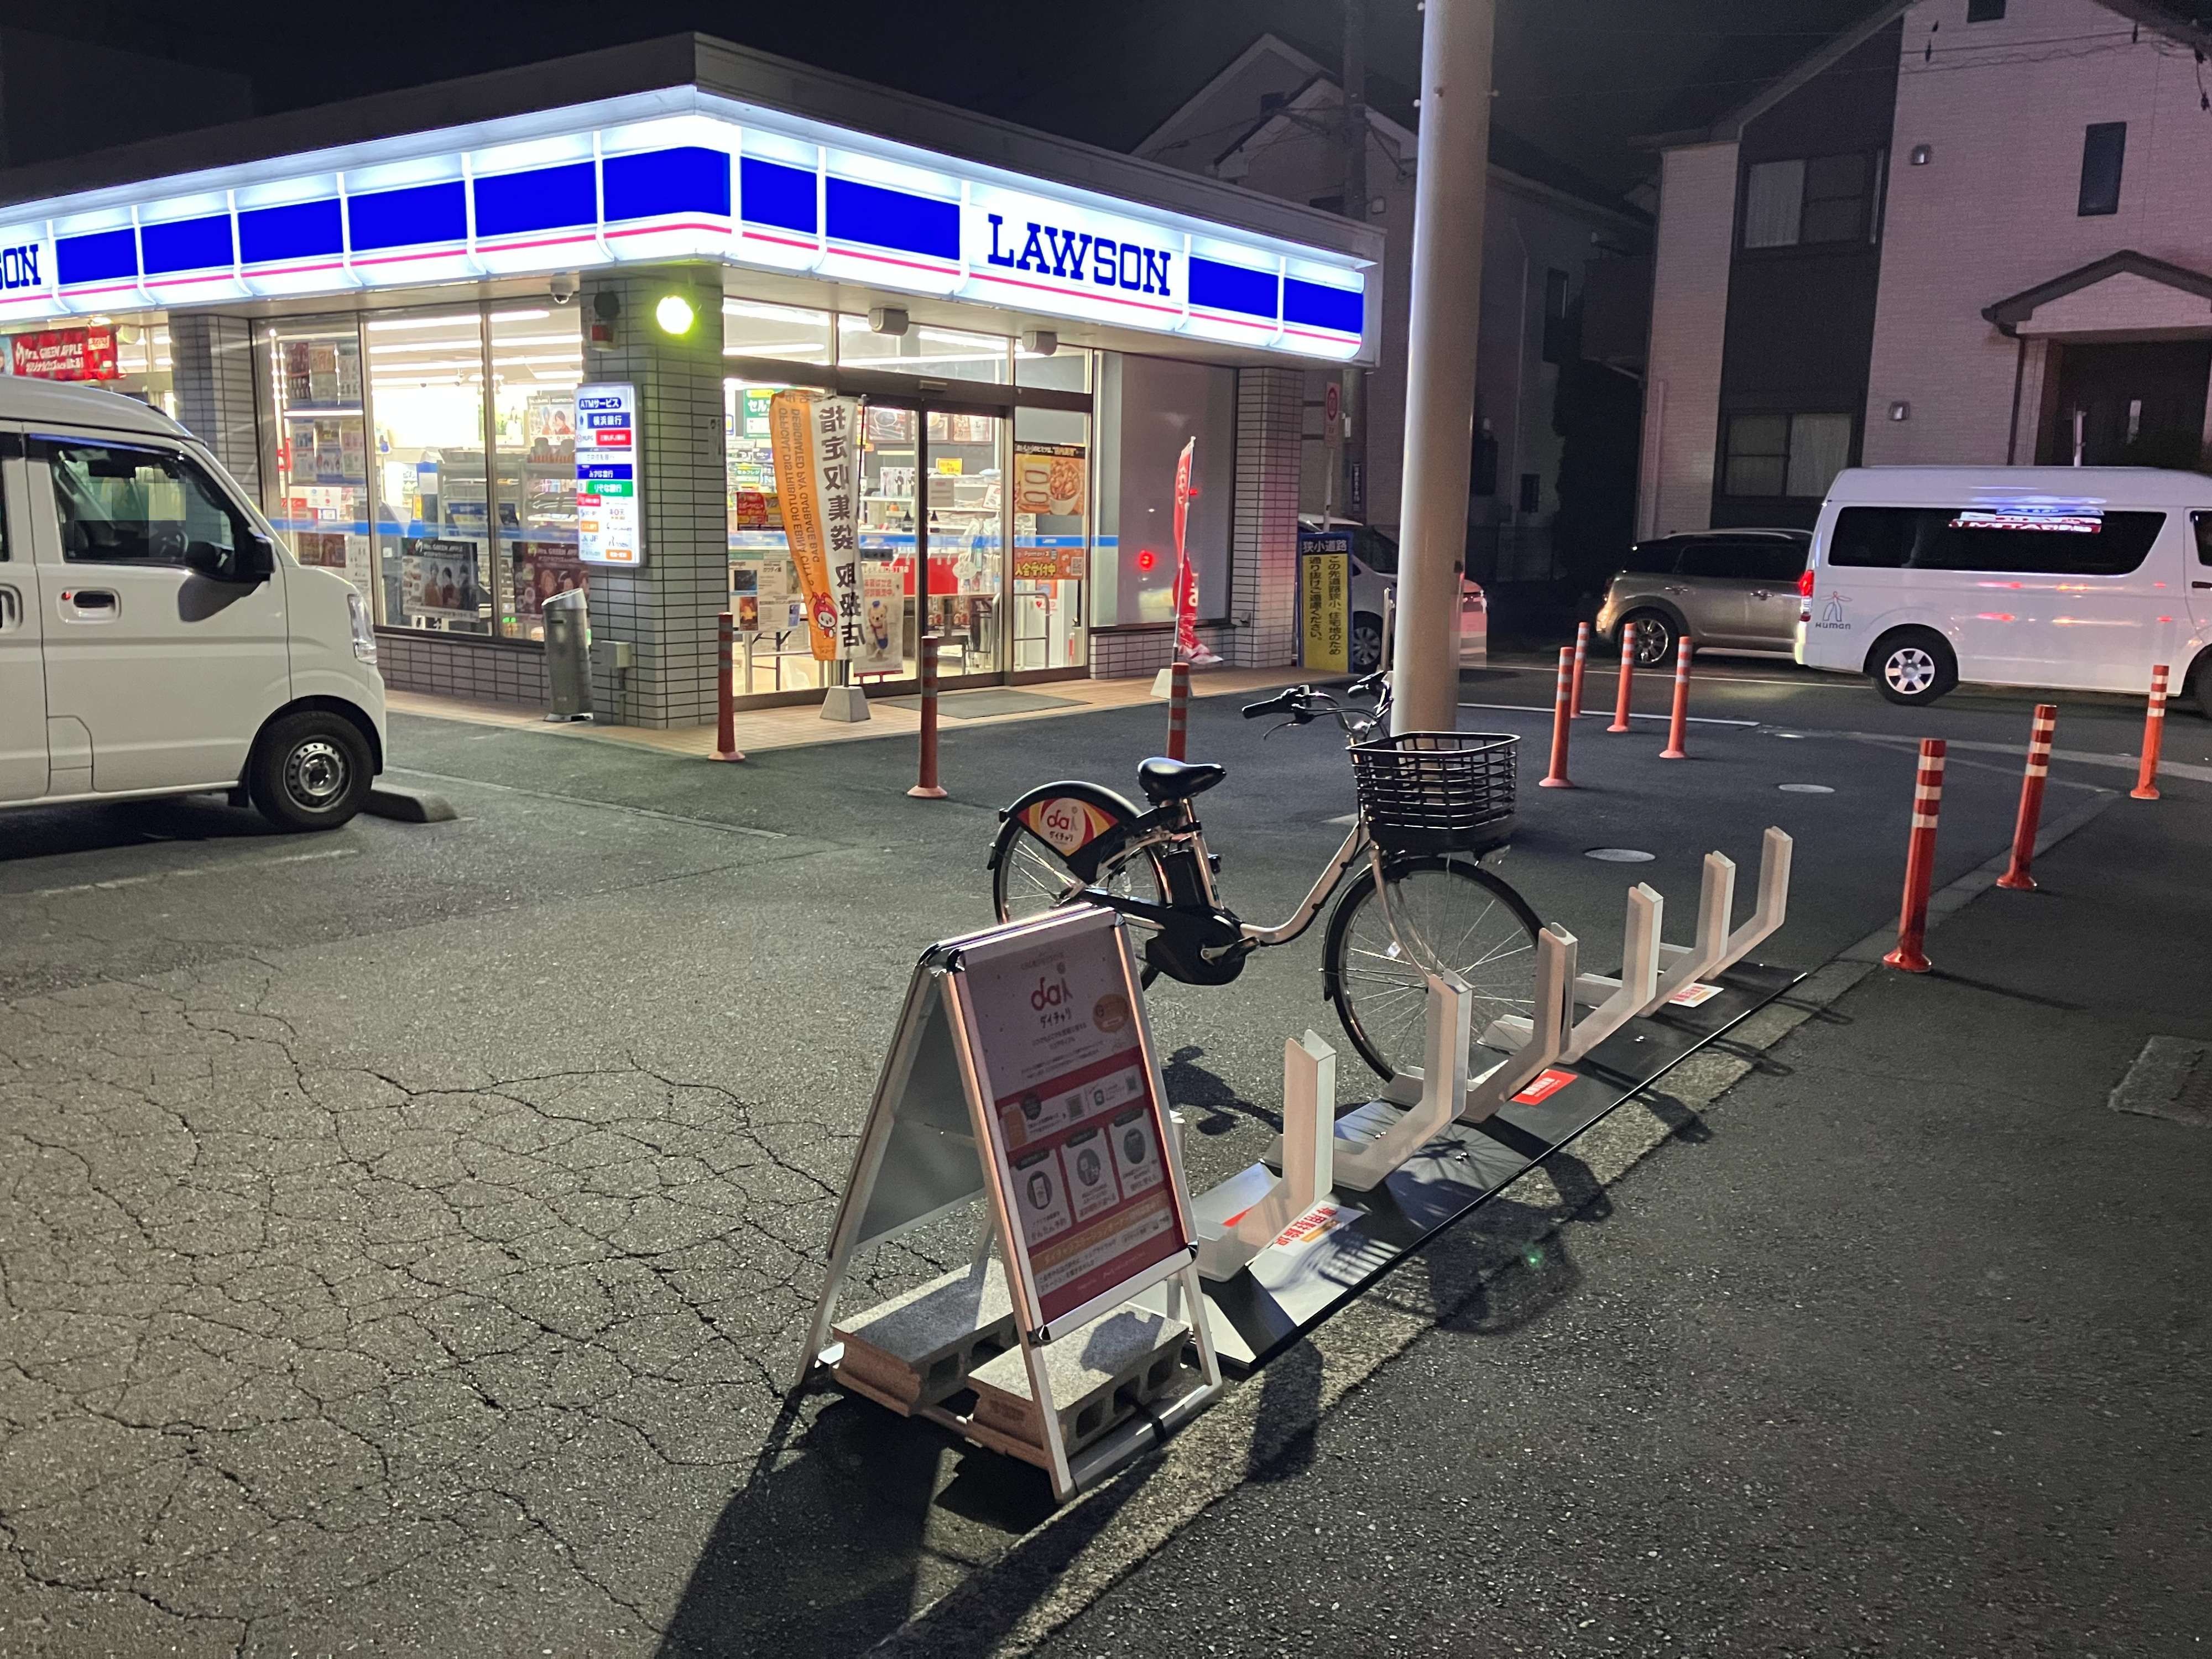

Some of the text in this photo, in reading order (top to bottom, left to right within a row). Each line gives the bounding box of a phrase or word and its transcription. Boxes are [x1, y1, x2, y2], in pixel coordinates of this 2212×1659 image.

[988, 213, 1171, 296] LAWSON
[0, 244, 41, 290] ON
[40, 346, 60, 359] GREEN
[60, 343, 82, 357] APPLE
[581, 399, 619, 408] ATMサービス
[593, 416, 622, 426] 横浜銀行
[1303, 540, 1347, 552] 狭小道路
[1015, 562, 1056, 577] 入会受付中
[1310, 557, 1322, 640] 通り抜けご遠慮ください。
[1328, 556, 1341, 655] この先道路狭小、住宅地のため
[1047, 806, 1078, 830] dai
[1050, 831, 1073, 842] ダイチャリ
[1031, 962, 1073, 1011] dai
[1040, 1008, 1071, 1028] ダイチャリ
